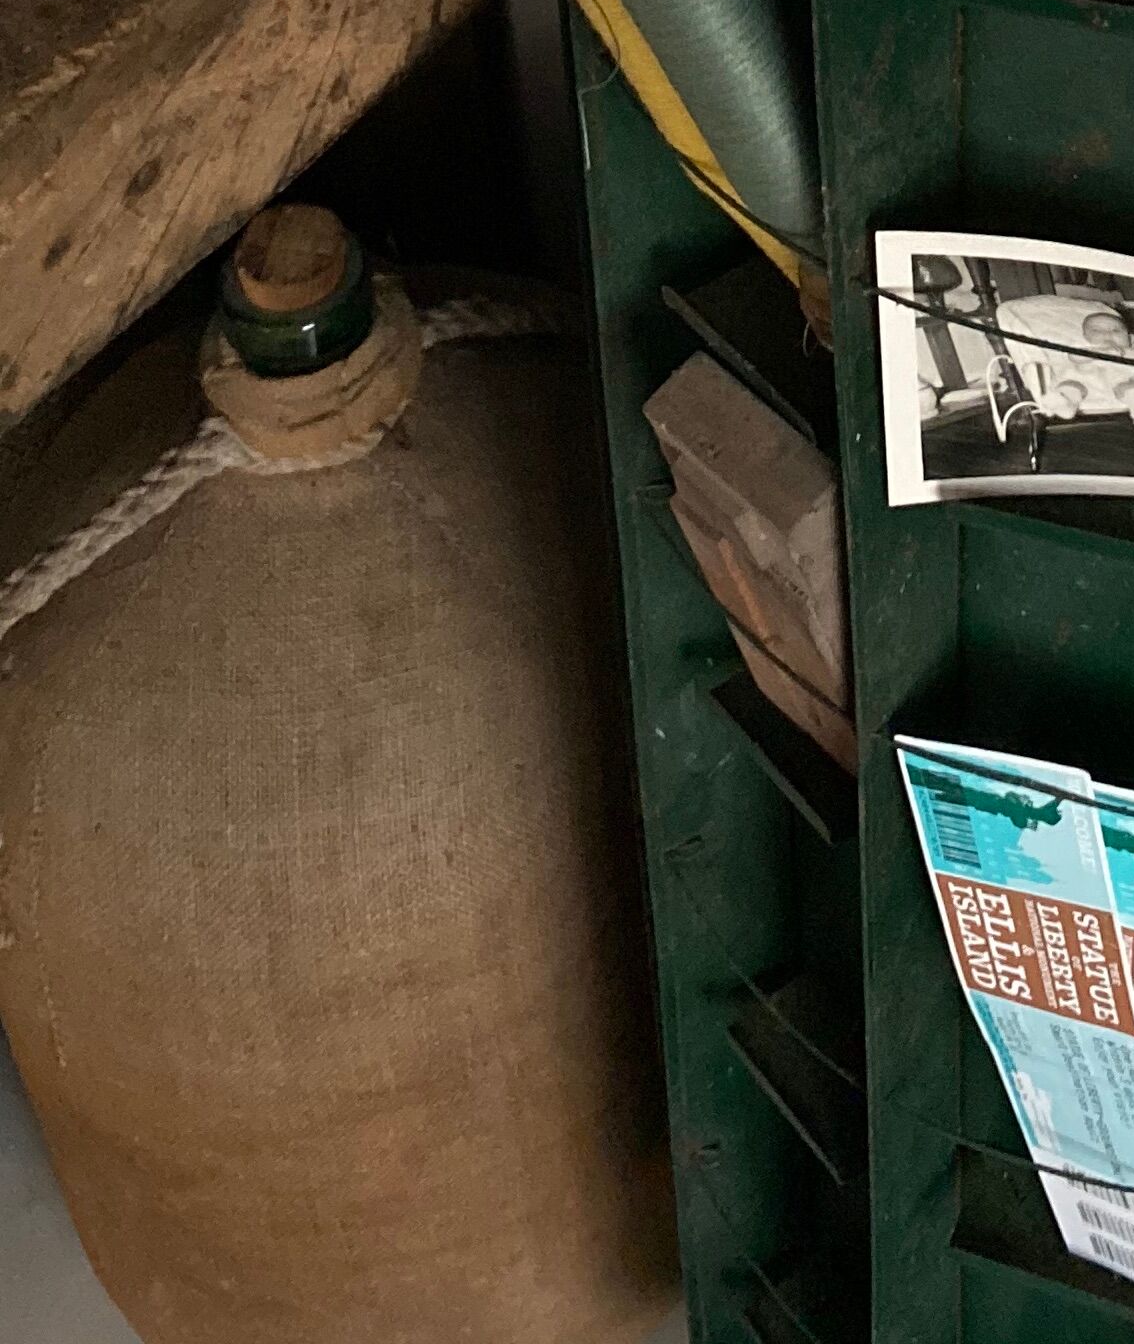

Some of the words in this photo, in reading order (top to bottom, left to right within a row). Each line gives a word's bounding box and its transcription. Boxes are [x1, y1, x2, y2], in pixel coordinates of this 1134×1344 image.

[948, 882, 998, 991] ISLAND
[976, 888, 1033, 1001] ELLIS
[1037, 901, 1082, 1016] LIBERTY
[1072, 911, 1120, 1025] STATUE
